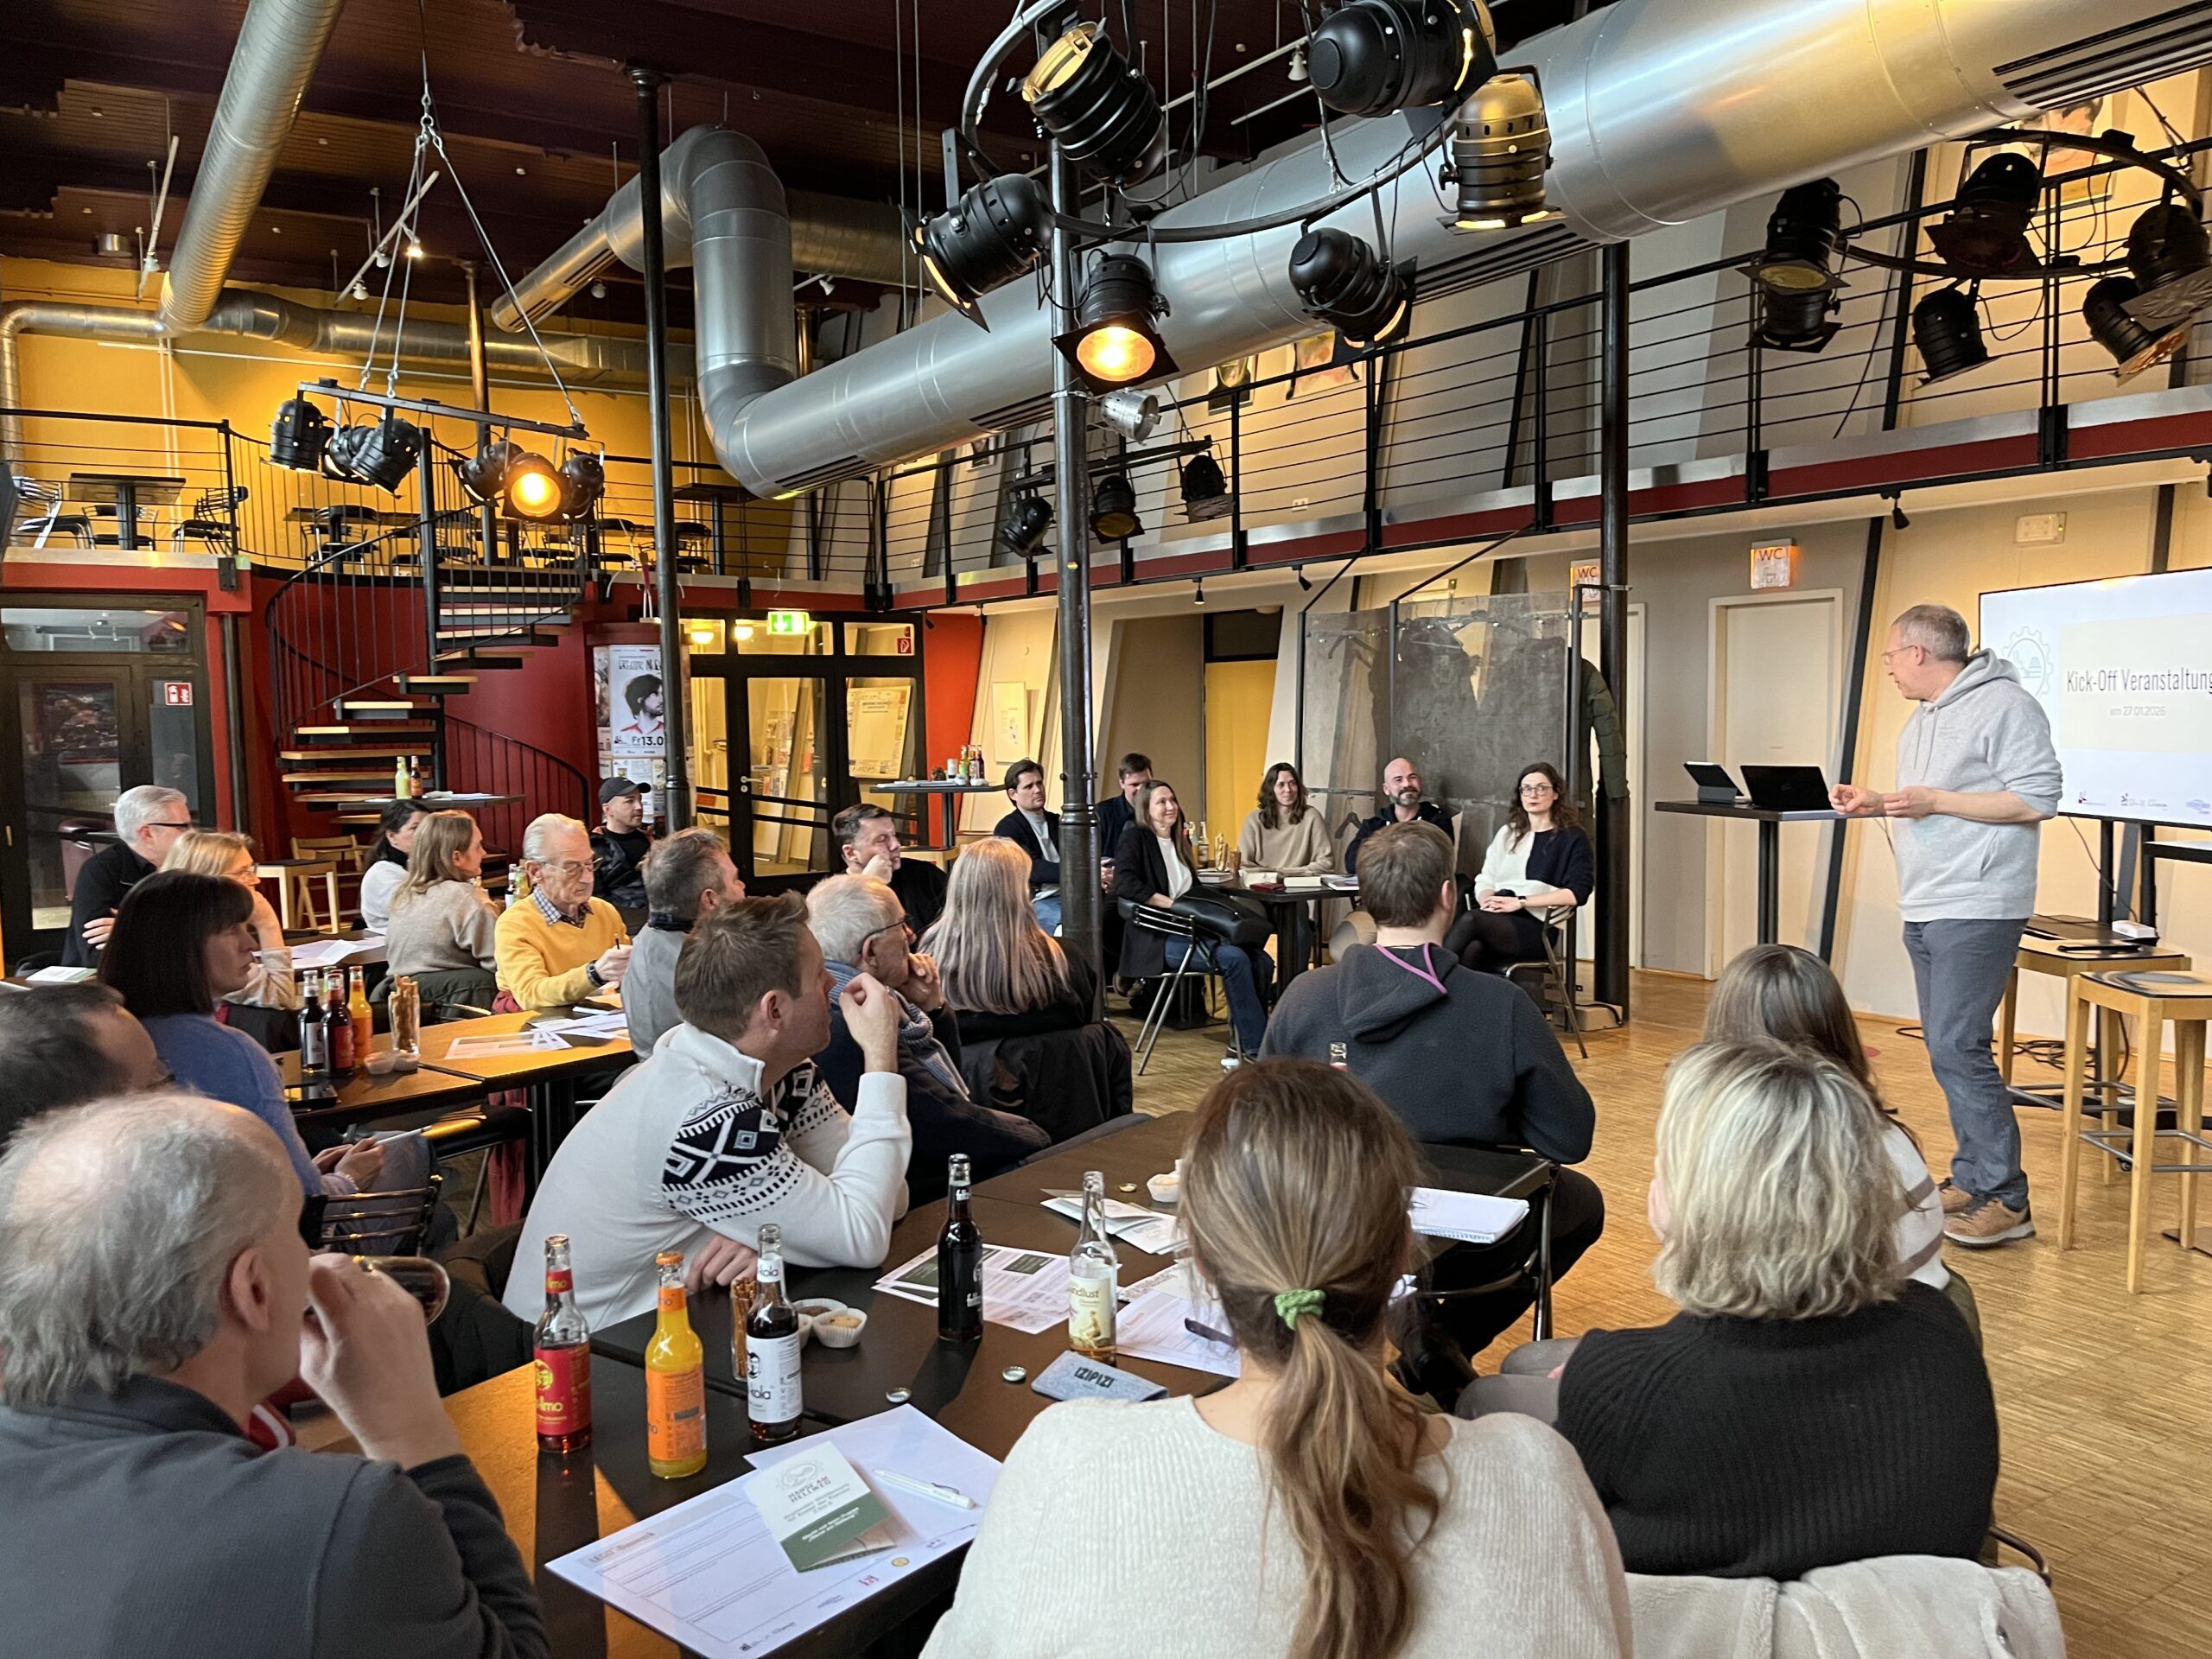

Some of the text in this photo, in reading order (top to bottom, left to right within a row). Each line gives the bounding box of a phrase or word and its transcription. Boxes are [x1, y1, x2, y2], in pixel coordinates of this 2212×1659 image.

[1758, 548, 1783, 561] WC
[1577, 566, 1597, 578] WC
[2067, 670, 2118, 692] Kick-Off
[641, 735, 664, 746] 13.0
[1074, 1367, 1115, 1389] IZIPIZI
